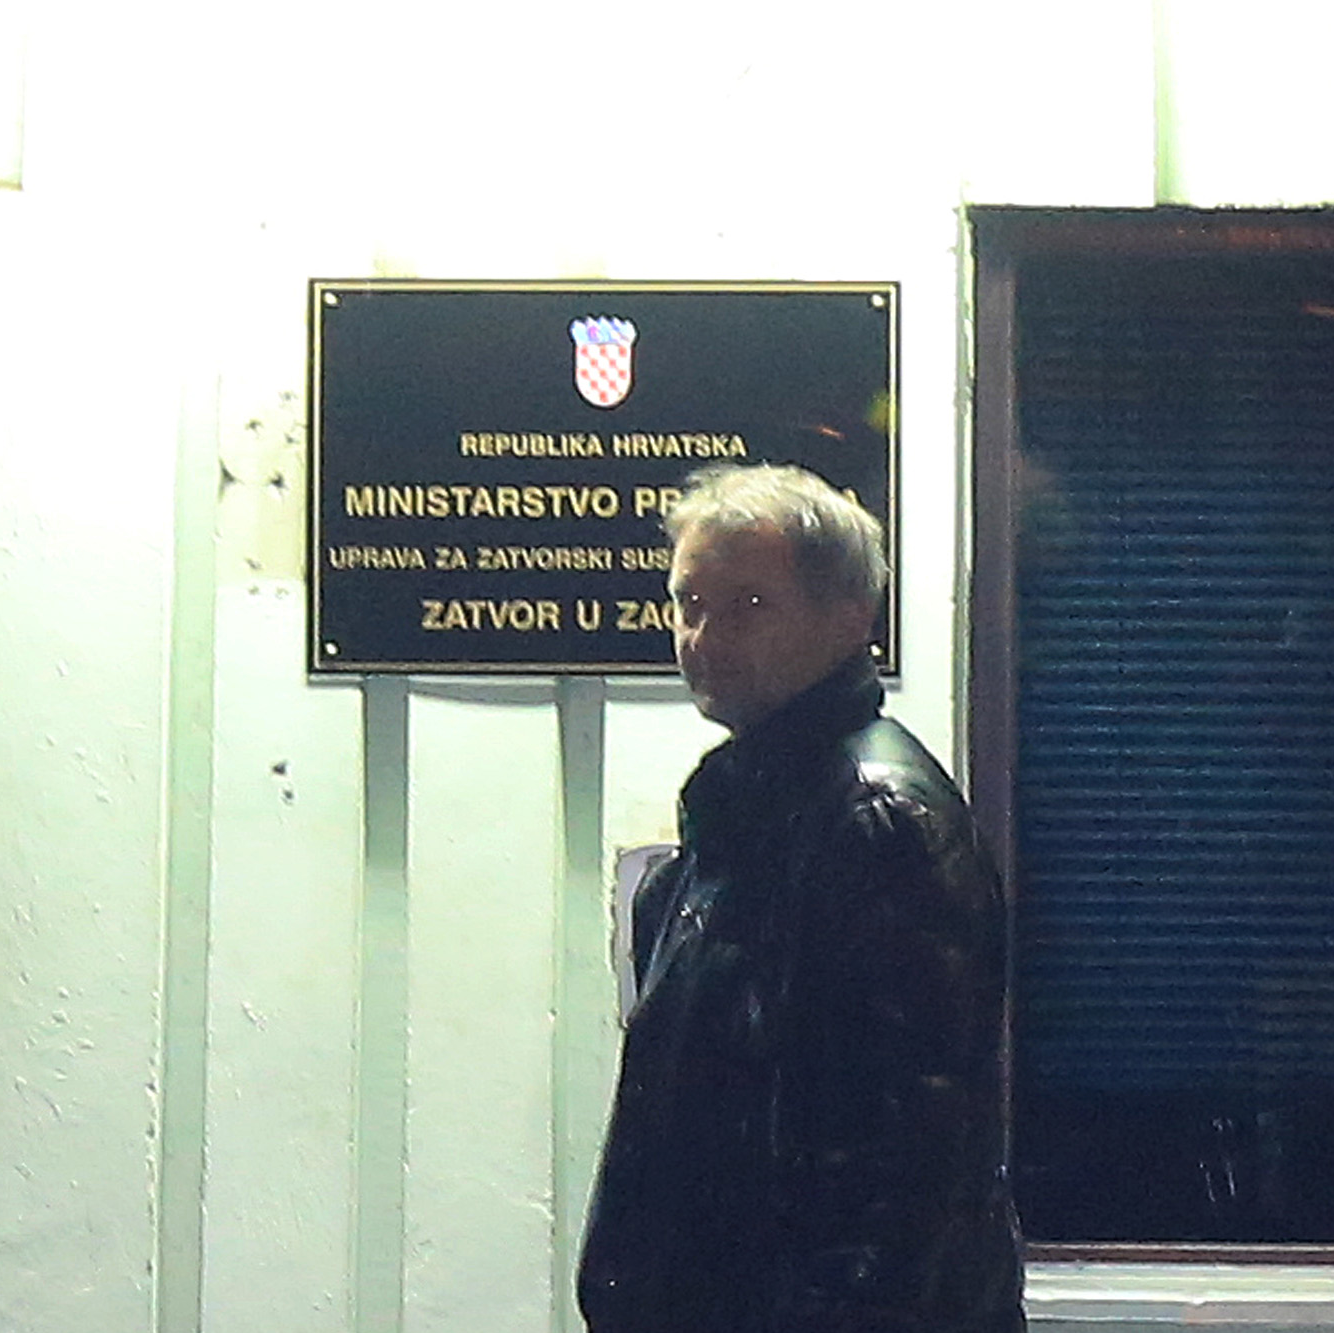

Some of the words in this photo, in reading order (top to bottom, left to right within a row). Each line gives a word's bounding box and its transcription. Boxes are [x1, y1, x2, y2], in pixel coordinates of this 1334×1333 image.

[461, 433, 605, 458] REPUBLIKA
[613, 433, 746, 458] HRVATSKA
[345, 486, 619, 518] MINISTARSTVO
[330, 548, 426, 571] UPRAVA
[436, 548, 467, 571] ZA
[479, 548, 613, 571] ZATVORSKI
[621, 549, 670, 571] SUS
[422, 600, 560, 630] ZATVOR
[577, 601, 602, 630] U
